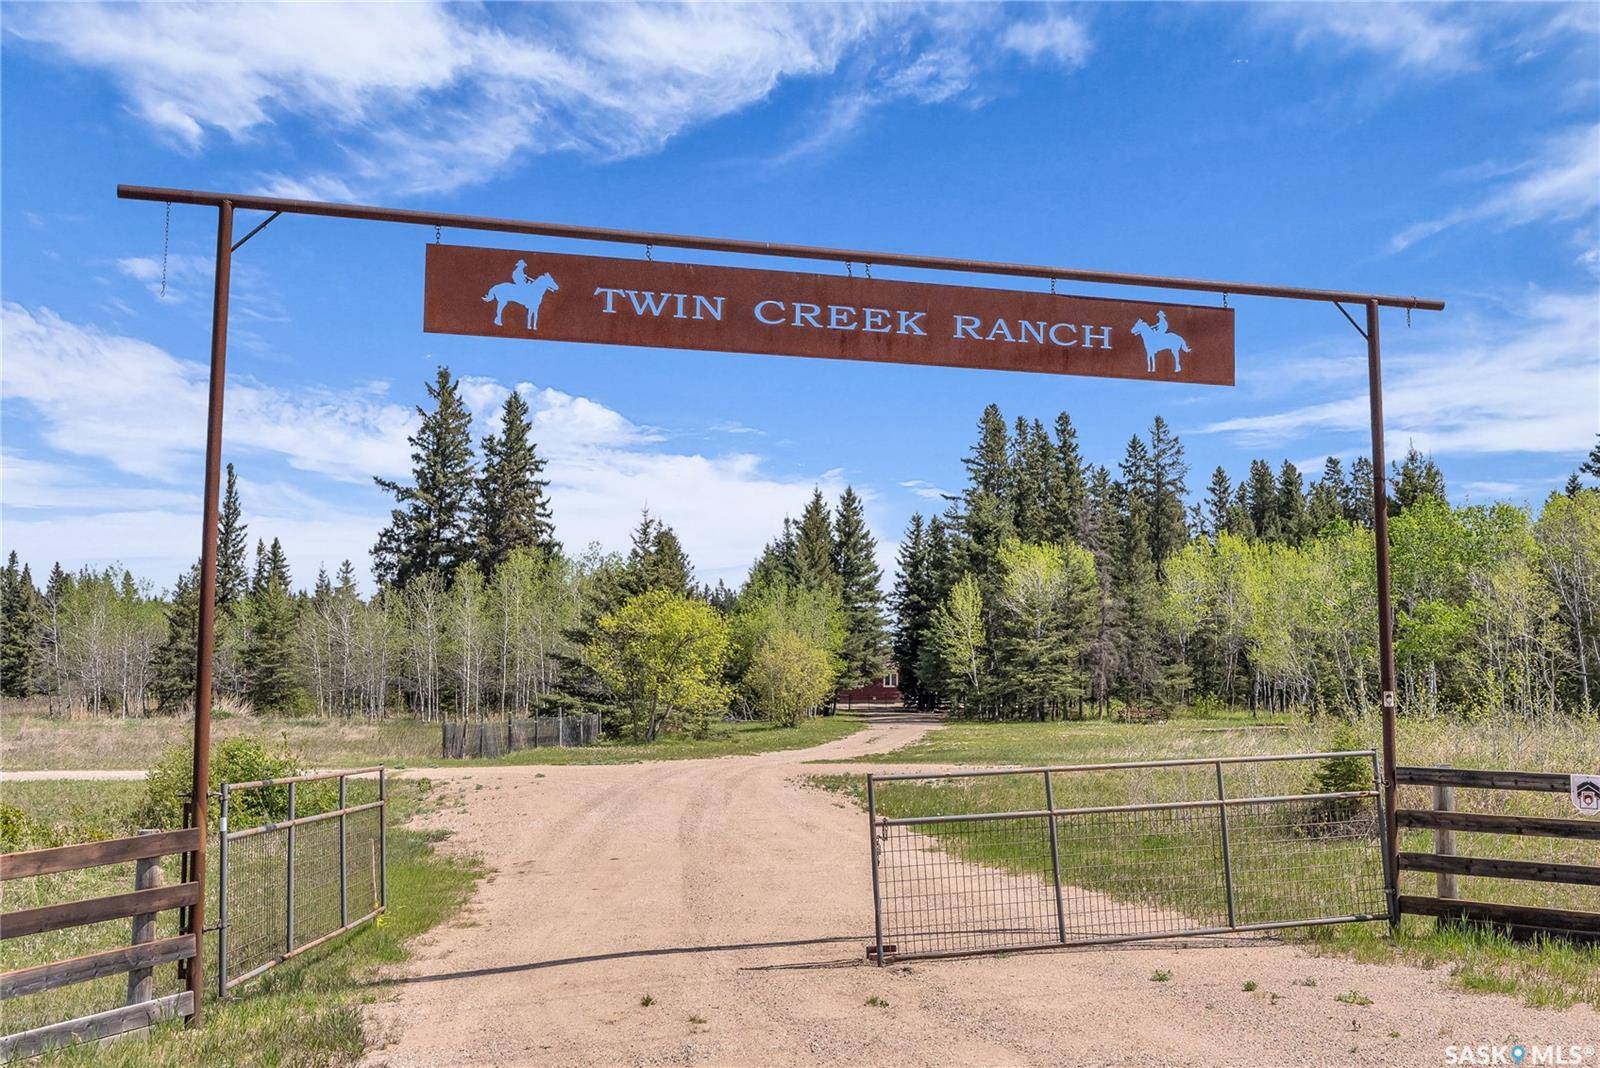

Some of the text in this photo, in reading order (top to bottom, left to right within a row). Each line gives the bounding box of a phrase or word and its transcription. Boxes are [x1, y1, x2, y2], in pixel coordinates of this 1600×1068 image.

[593, 287, 1112, 350] TWIN CREEK RANCH
